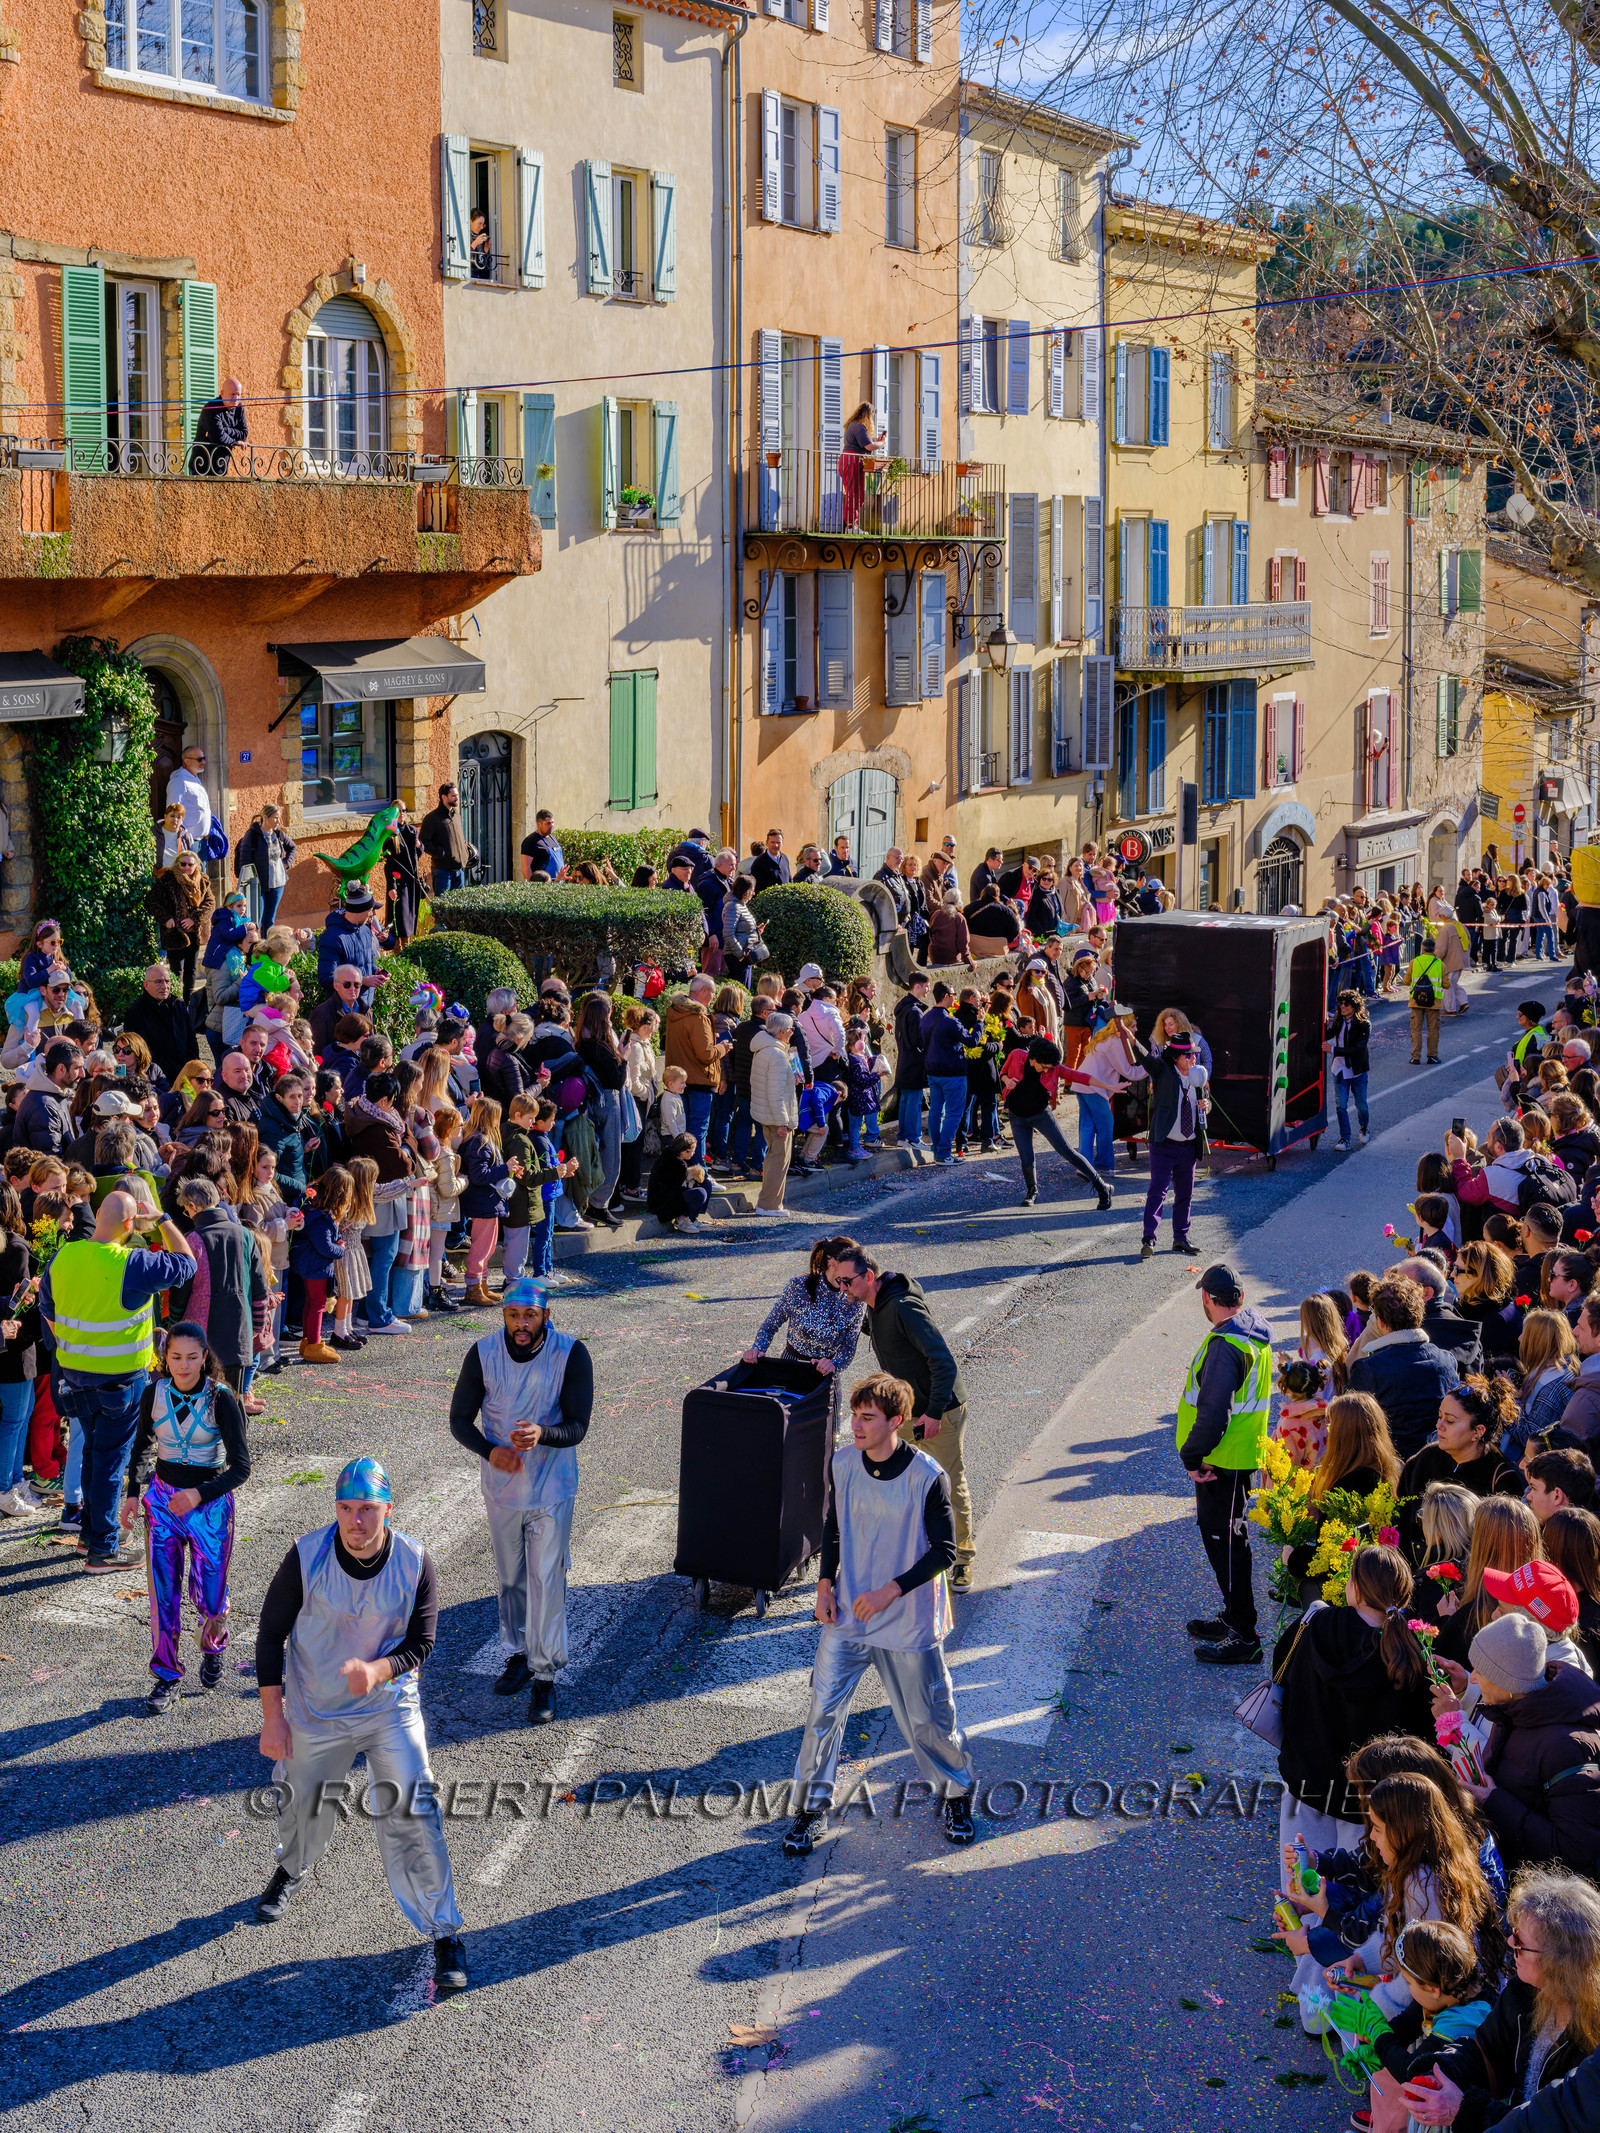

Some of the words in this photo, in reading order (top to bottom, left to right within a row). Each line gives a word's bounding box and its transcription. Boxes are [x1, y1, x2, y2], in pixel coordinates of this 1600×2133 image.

[383, 675, 416, 687] MAGREY
[418, 674, 423, 684] &
[425, 673, 445, 684] SONS
[2, 695, 10, 706] &
[12, 693, 40, 706] SONS
[242, 753, 250, 761] 27
[1120, 831, 1143, 842] BARNES
[1126, 840, 1138, 857] B
